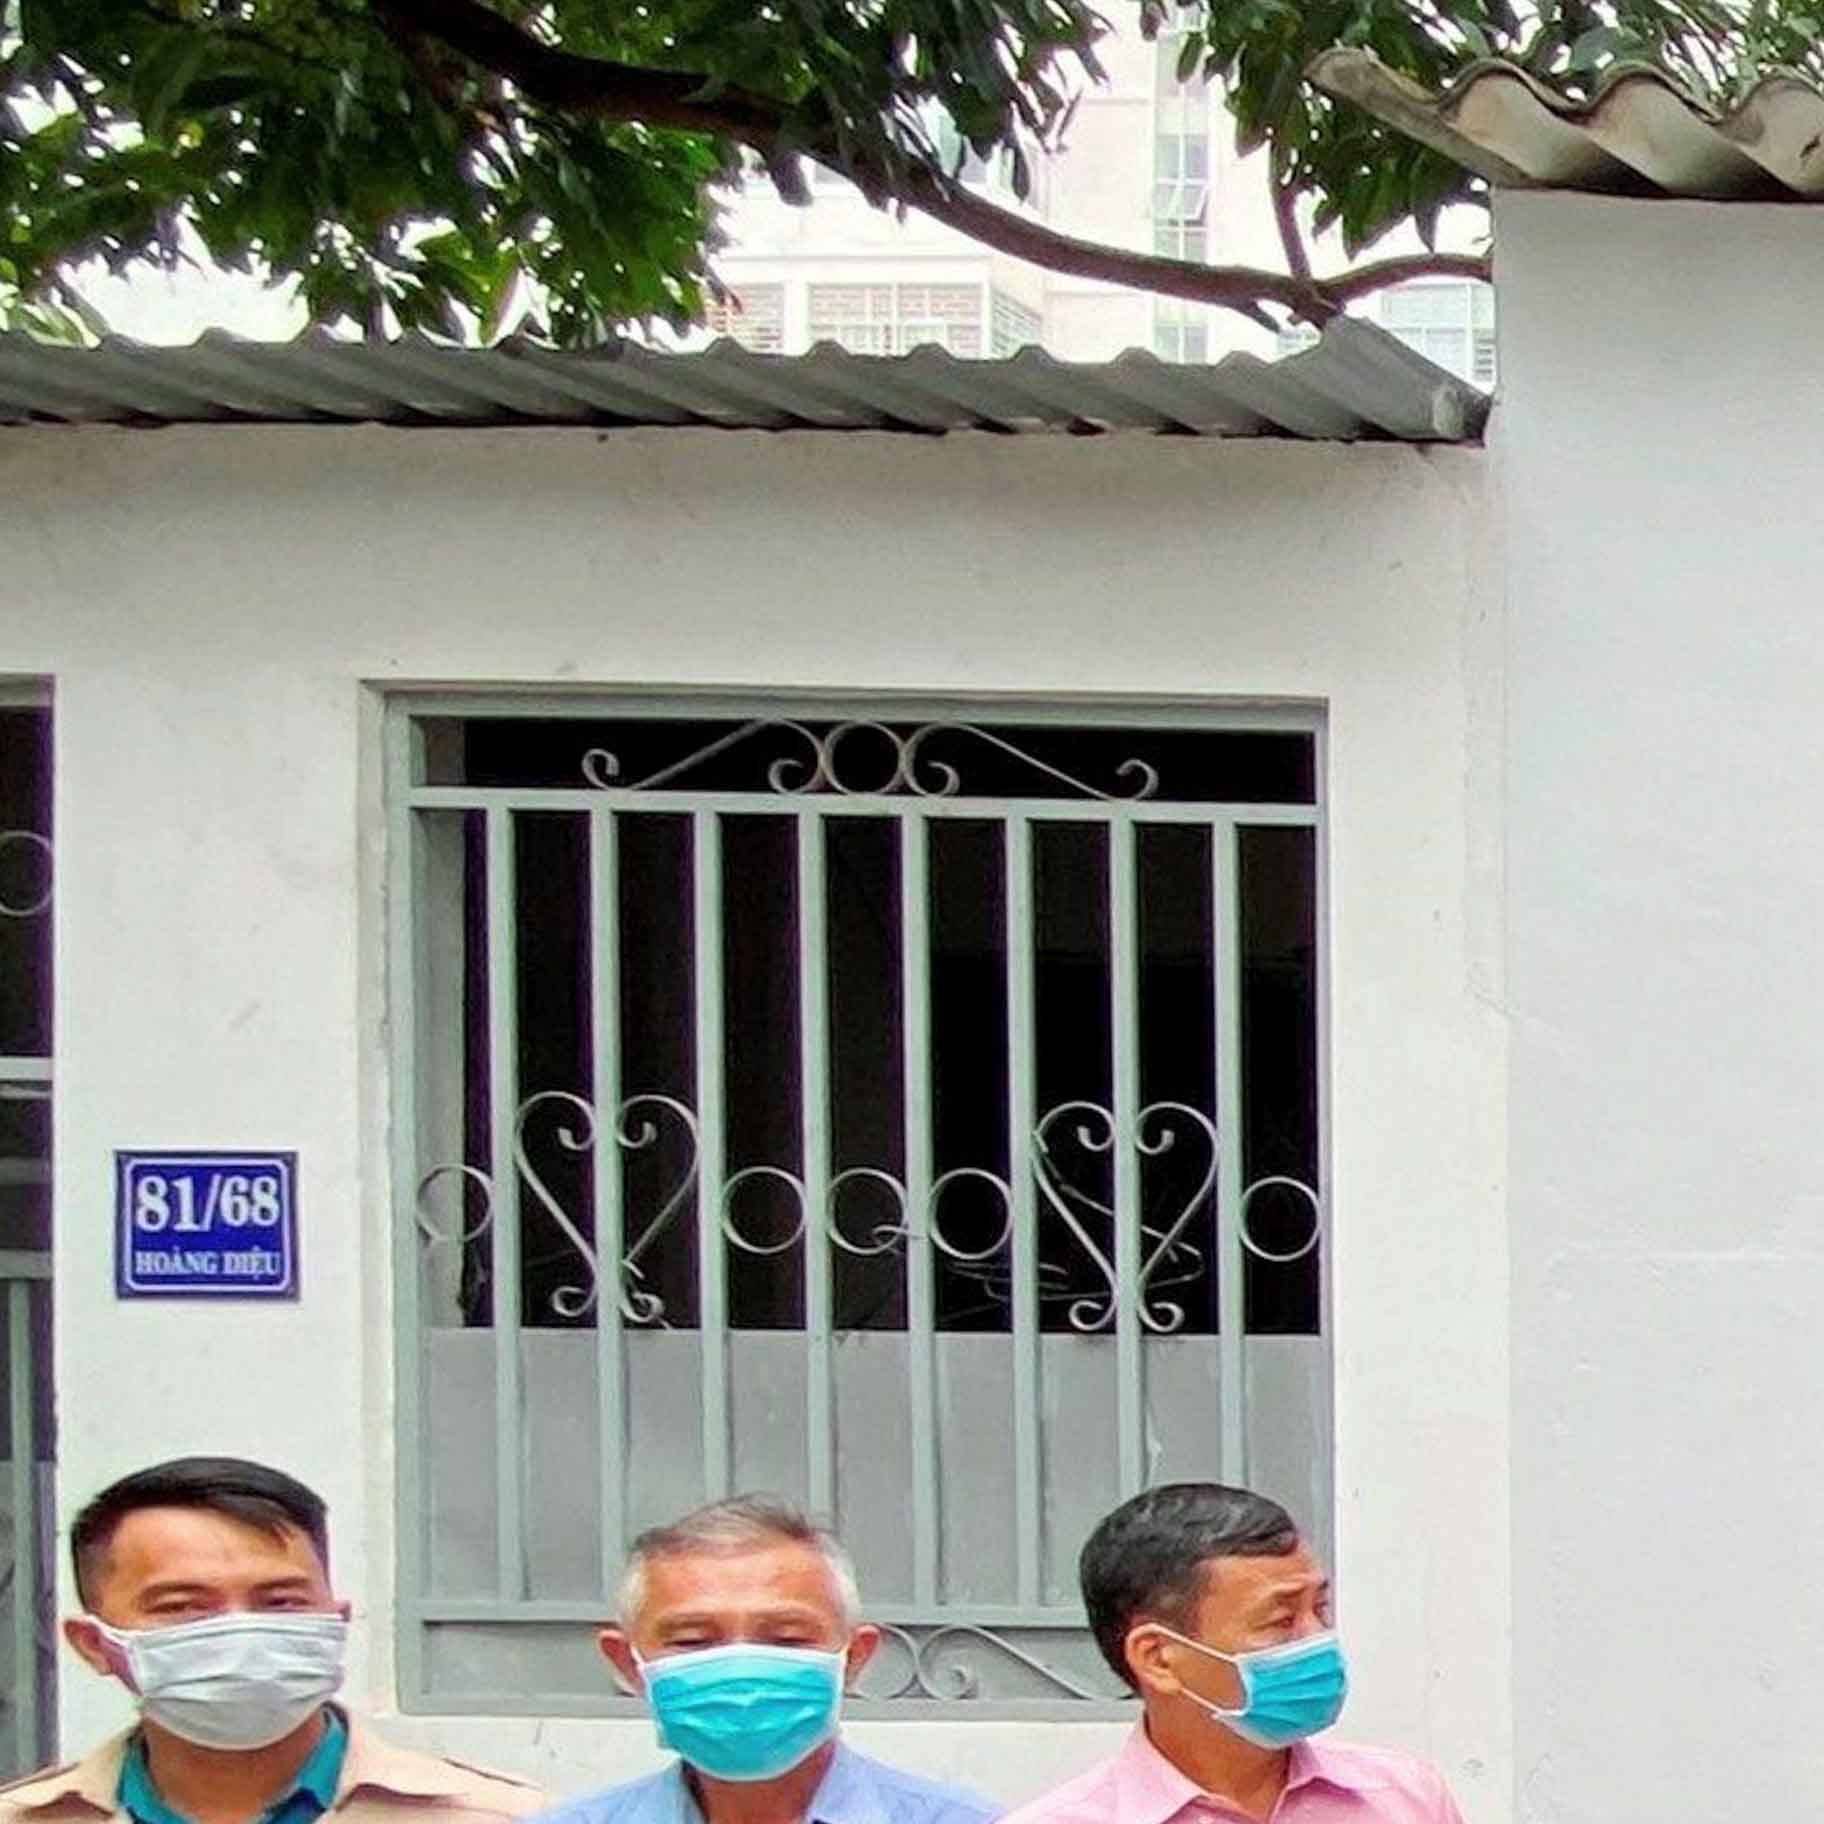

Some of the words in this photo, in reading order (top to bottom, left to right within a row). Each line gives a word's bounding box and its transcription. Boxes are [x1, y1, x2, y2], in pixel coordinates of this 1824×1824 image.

[135, 1174, 280, 1232] 81/68
[135, 1246, 218, 1275] HOÀNG
[223, 1245, 280, 1280] DIỆU
